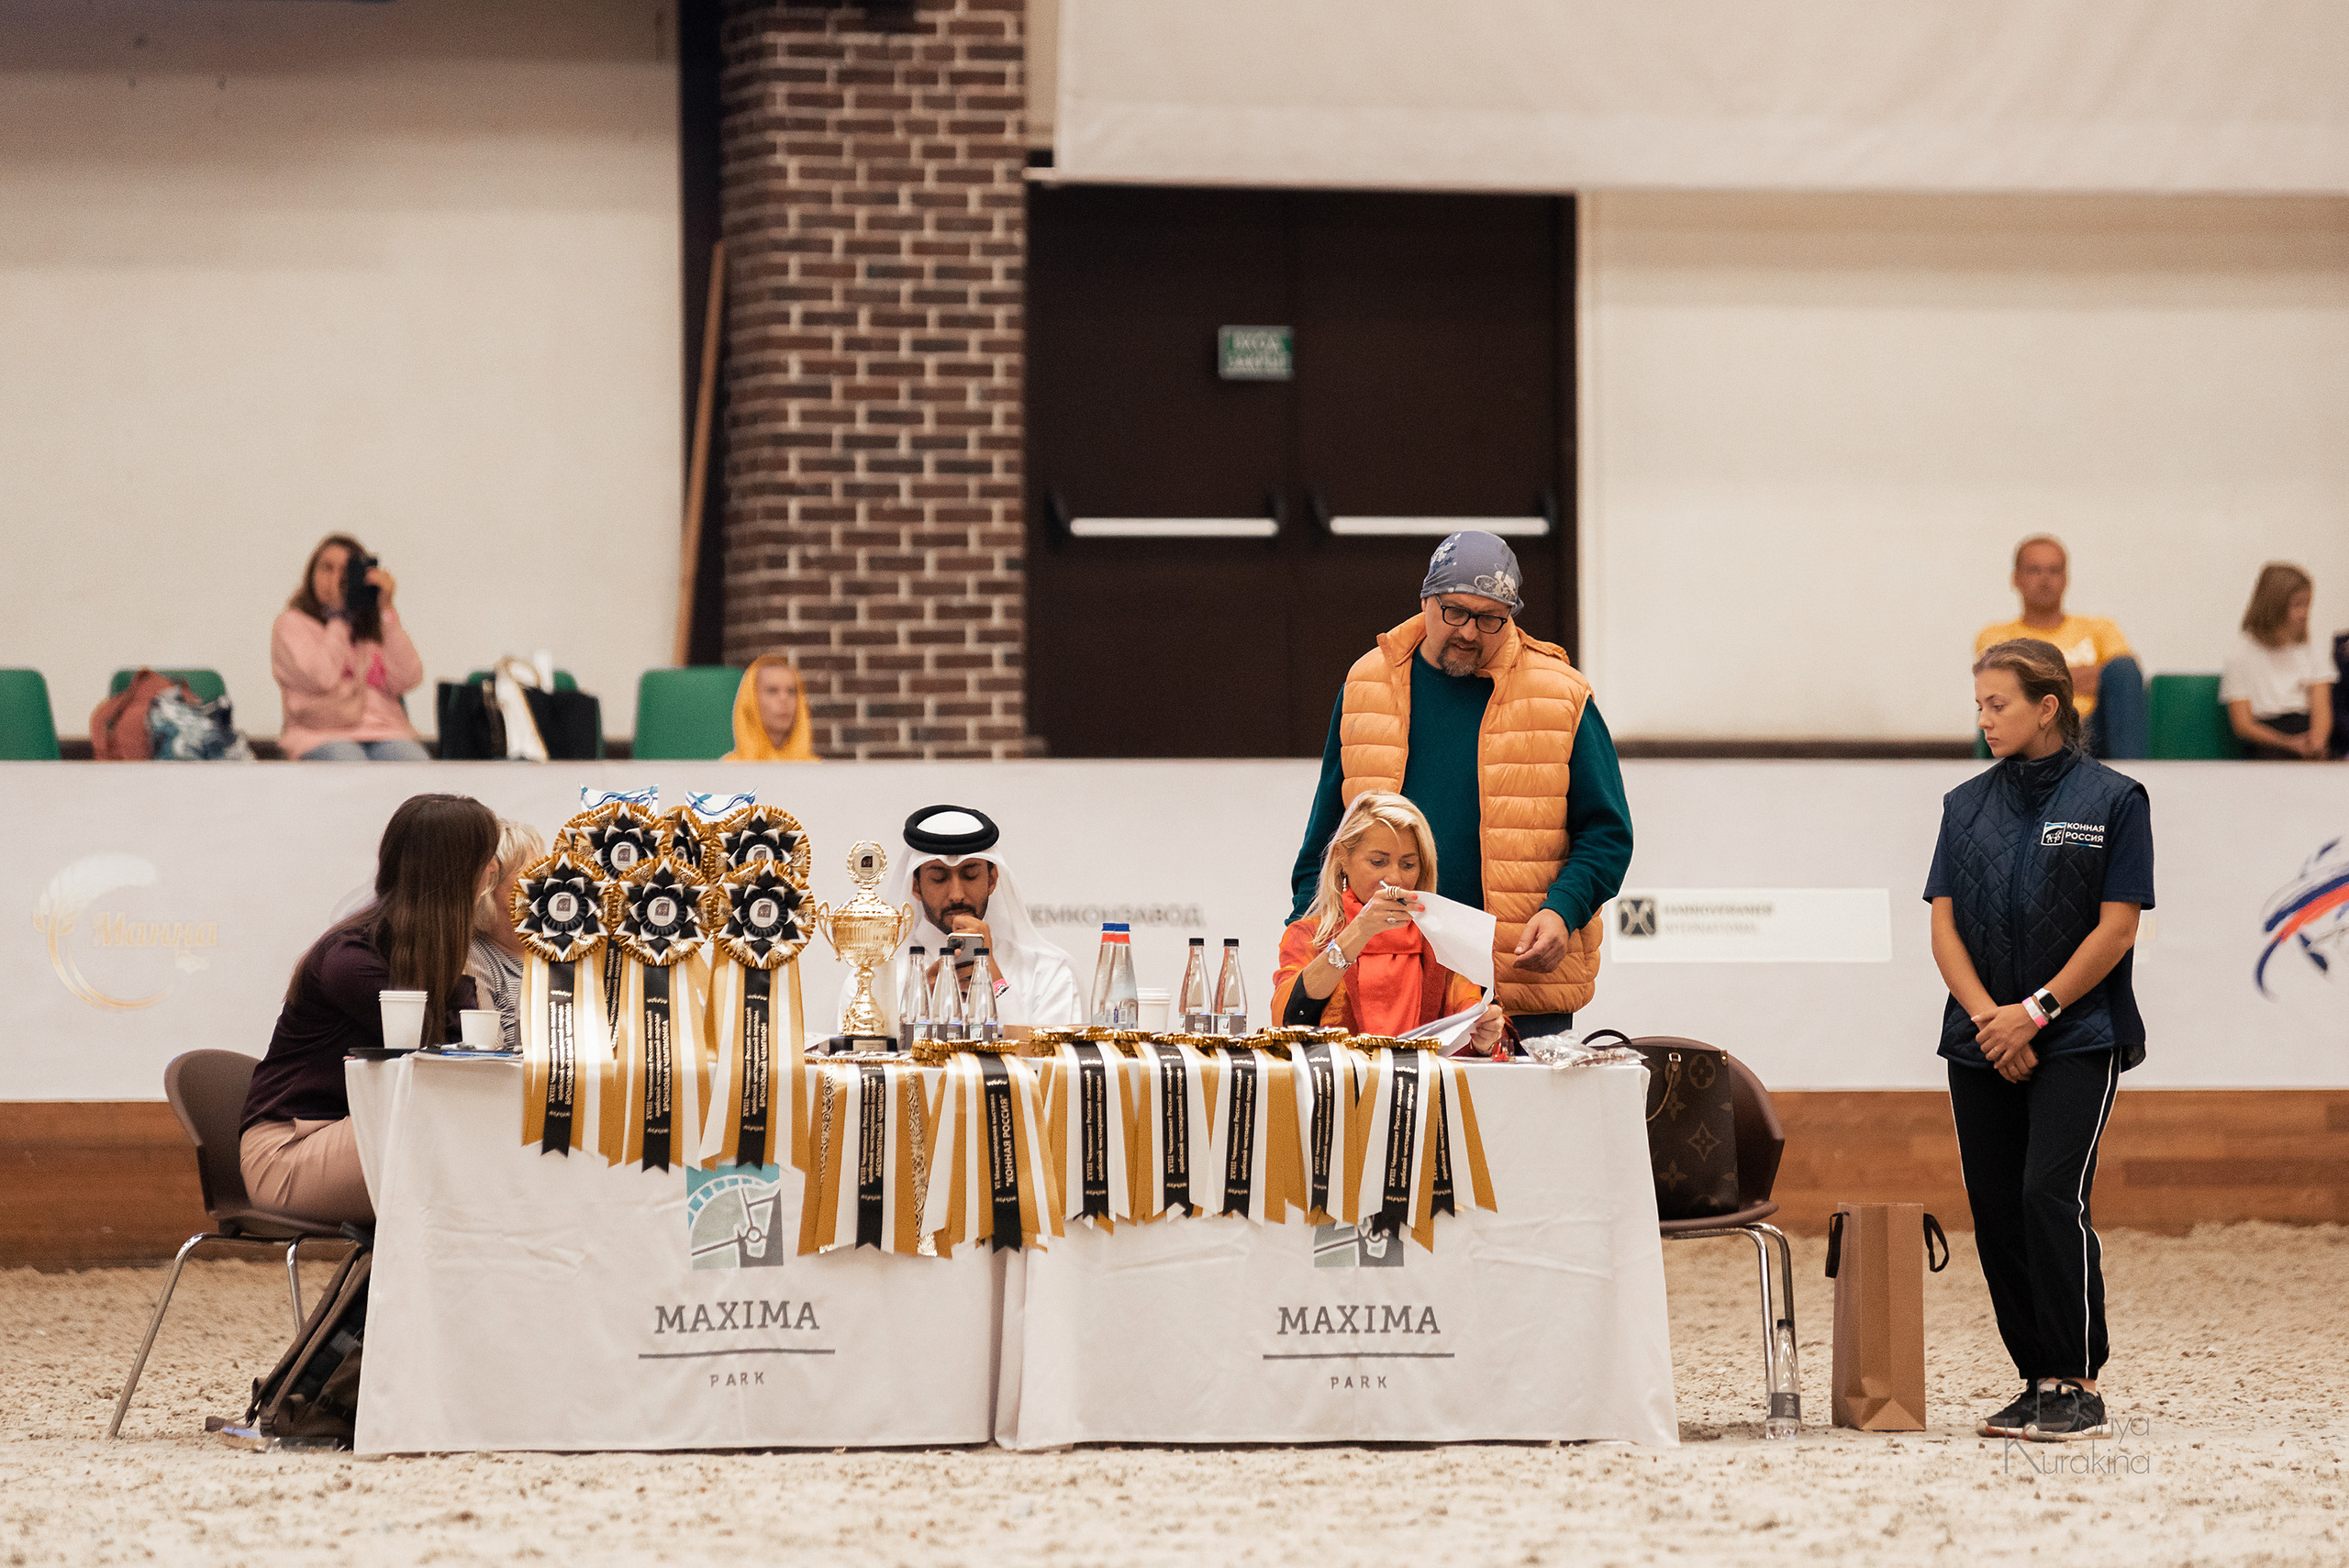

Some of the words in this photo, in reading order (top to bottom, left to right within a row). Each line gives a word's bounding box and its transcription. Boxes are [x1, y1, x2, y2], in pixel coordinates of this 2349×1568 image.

[2065, 831, 2104, 842] РОССИЯ
[2066, 823, 2105, 832] КОННАЯ
[1027, 904, 1205, 926] ЕМКОНЗАВОД
[662, 1019, 671, 1066] ЧЕМПИОНКА
[760, 1022, 768, 1060] ЧЕМПИОН
[565, 1059, 574, 1105] БРОНЗОВЫЙ
[662, 1068, 671, 1112] БРОНЗОВАЯ
[759, 1061, 768, 1107] БРОНЗОВЫЙ
[1396, 1076, 1404, 1106] лошадей
[1406, 1084, 1414, 1109] породы
[645, 1101, 653, 1120] XVIII
[1393, 1106, 1401, 1129] России
[1403, 1110, 1411, 1156] чистокровной
[874, 1122, 884, 1177] АБСОЛЮТНЫЙ
[992, 1125, 1001, 1180] Международная
[1390, 1131, 1399, 1167] Чемпионат
[994, 1181, 1001, 1190] VI
[1400, 1157, 1408, 1188] арабской
[654, 1300, 819, 1334] MAXIMA
[1276, 1305, 1442, 1334] MAXIMA
[709, 1371, 765, 1388] PARK
[1330, 1375, 1387, 1390] PARK
